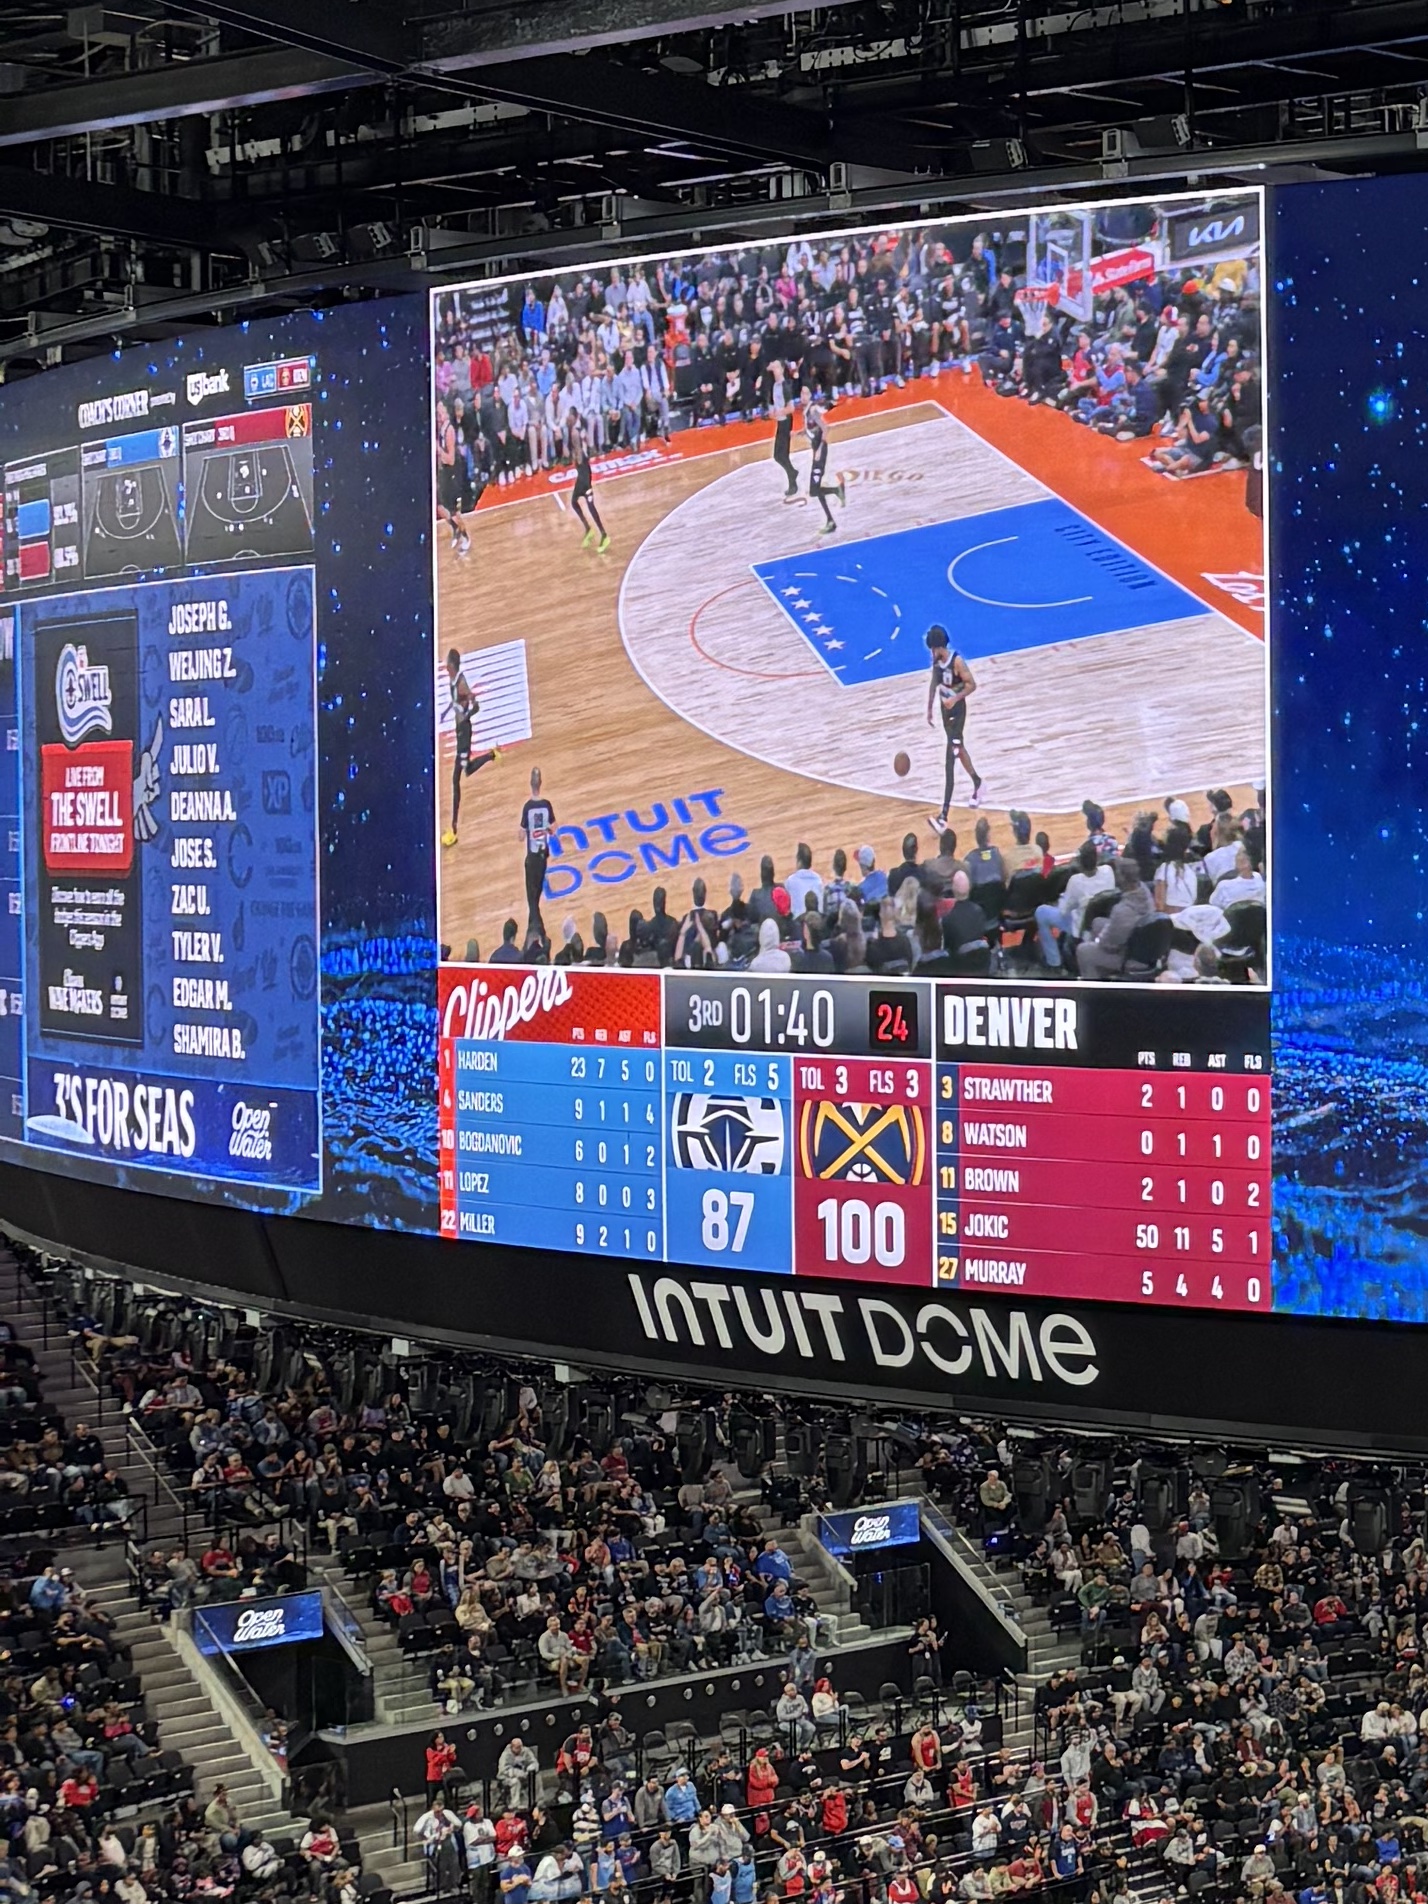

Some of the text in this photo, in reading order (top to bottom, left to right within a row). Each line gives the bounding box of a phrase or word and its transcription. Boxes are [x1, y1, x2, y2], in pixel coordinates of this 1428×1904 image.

[688, 987, 835, 1047] 3RD 01:40
[877, 1004, 908, 1041] 24
[944, 995, 1078, 1050] DENVER
[458, 1052, 498, 1072] HARDEN
[458, 1093, 503, 1114] SANDERS
[964, 1077, 1053, 1104] STRAWTHER
[86, 1080, 196, 1157] FOR SEAS
[229, 1101, 272, 1160] Open Water
[964, 1122, 1026, 1148] WATSON
[459, 1131, 522, 1155] BOGDANOVIC
[460, 1173, 489, 1194] LOPEZ
[965, 1168, 1019, 1193] BROWN
[460, 1212, 495, 1234] MILLER
[702, 1189, 754, 1252] 87
[817, 1198, 905, 1267] 100
[964, 1214, 1158, 1249] JOKIC 50
[965, 1259, 1026, 1285] MURRAY
[628, 1273, 845, 1362] INTUIT
[234, 1609, 285, 1642] Open Water
